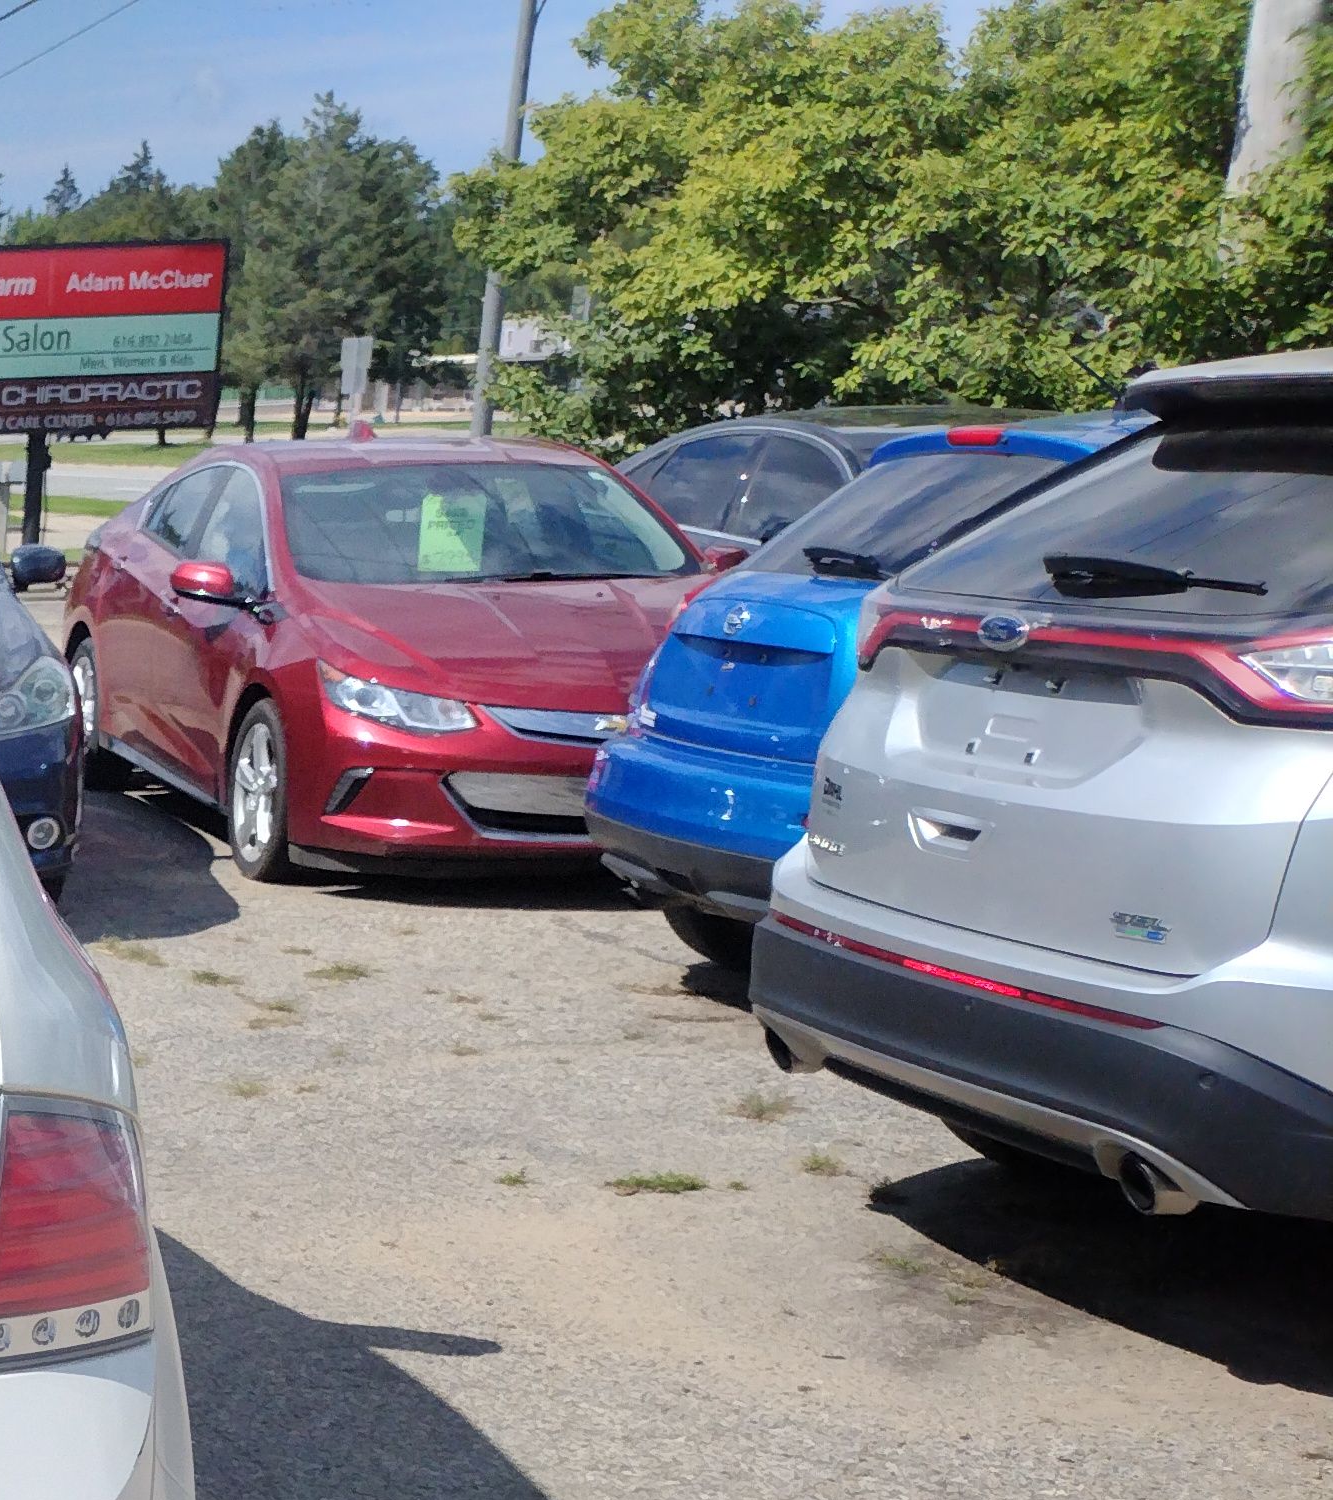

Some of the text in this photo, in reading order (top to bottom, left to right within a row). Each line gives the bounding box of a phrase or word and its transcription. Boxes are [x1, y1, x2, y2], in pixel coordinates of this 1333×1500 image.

[65, 271, 126, 293] Adam
[2, 323, 71, 353] Salon
[1, 379, 202, 407] CHIROPRACTIC
[5, 414, 41, 430] CARE
[43, 413, 96, 430] CENTER
